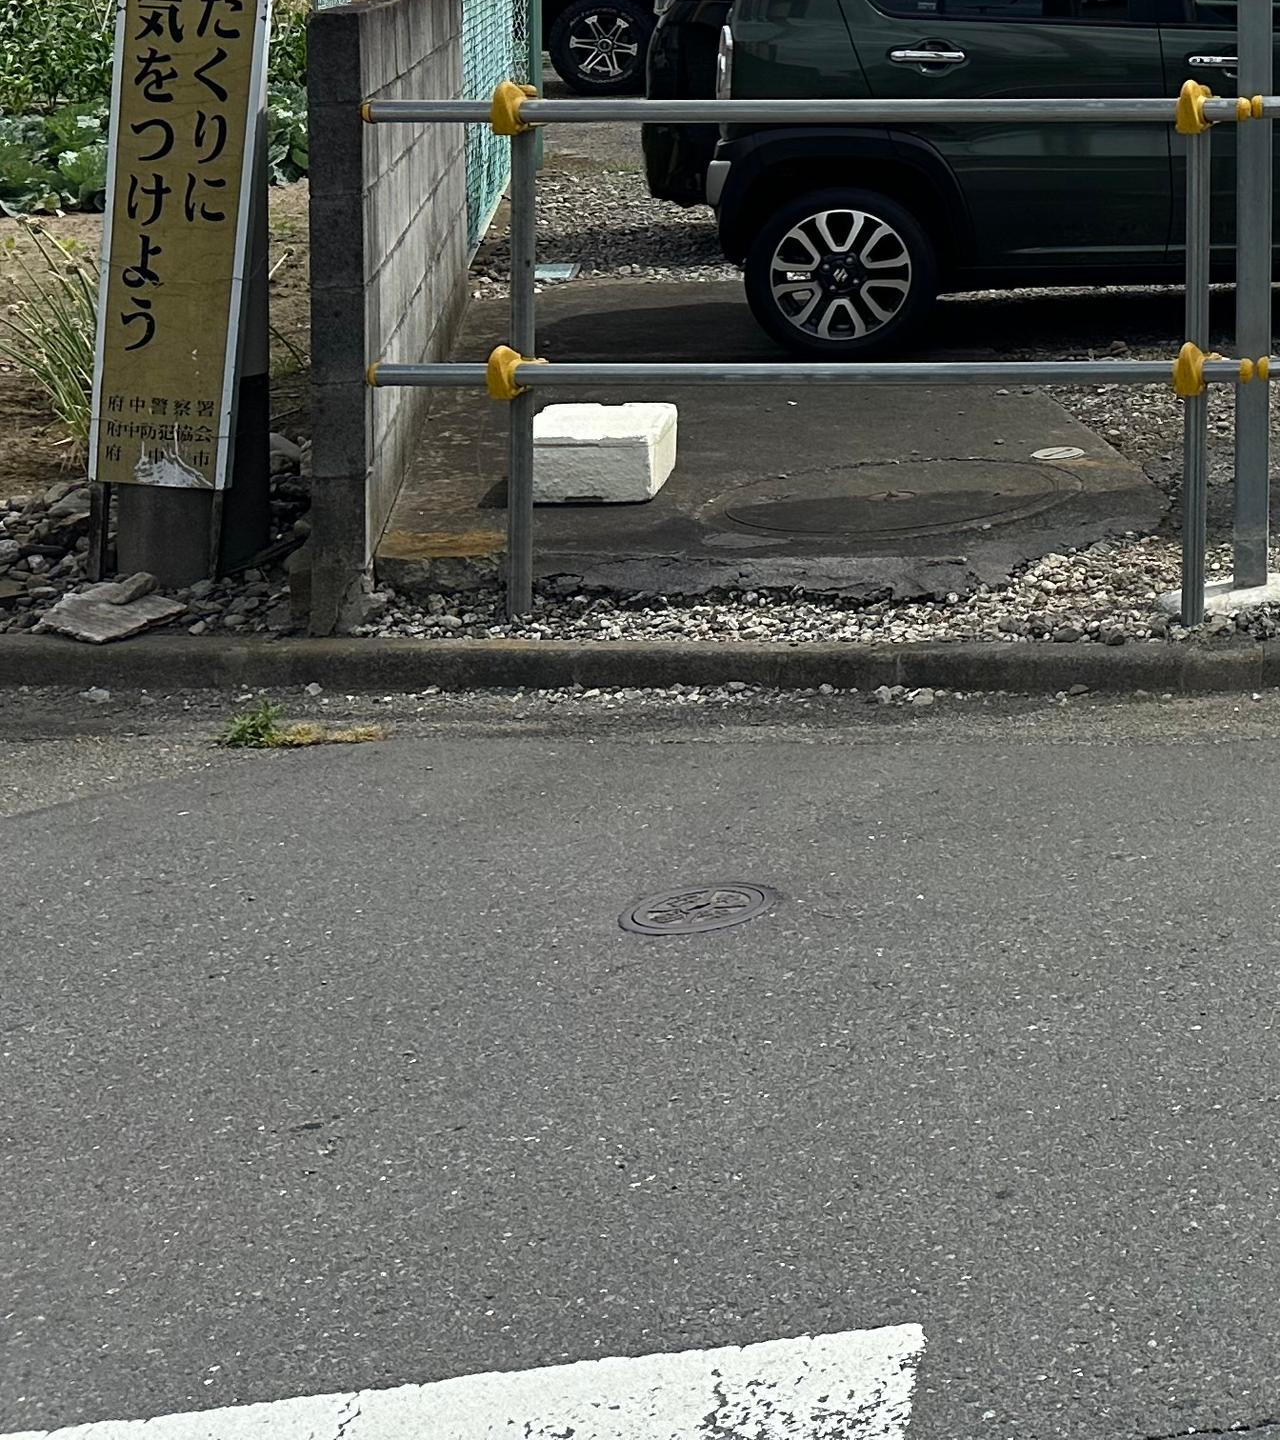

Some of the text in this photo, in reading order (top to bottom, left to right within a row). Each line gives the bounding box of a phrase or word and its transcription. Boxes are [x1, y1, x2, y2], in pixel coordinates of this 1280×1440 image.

[108, 395, 215, 417] 府中警察署
[106, 421, 213, 442] 府中防犯協会
